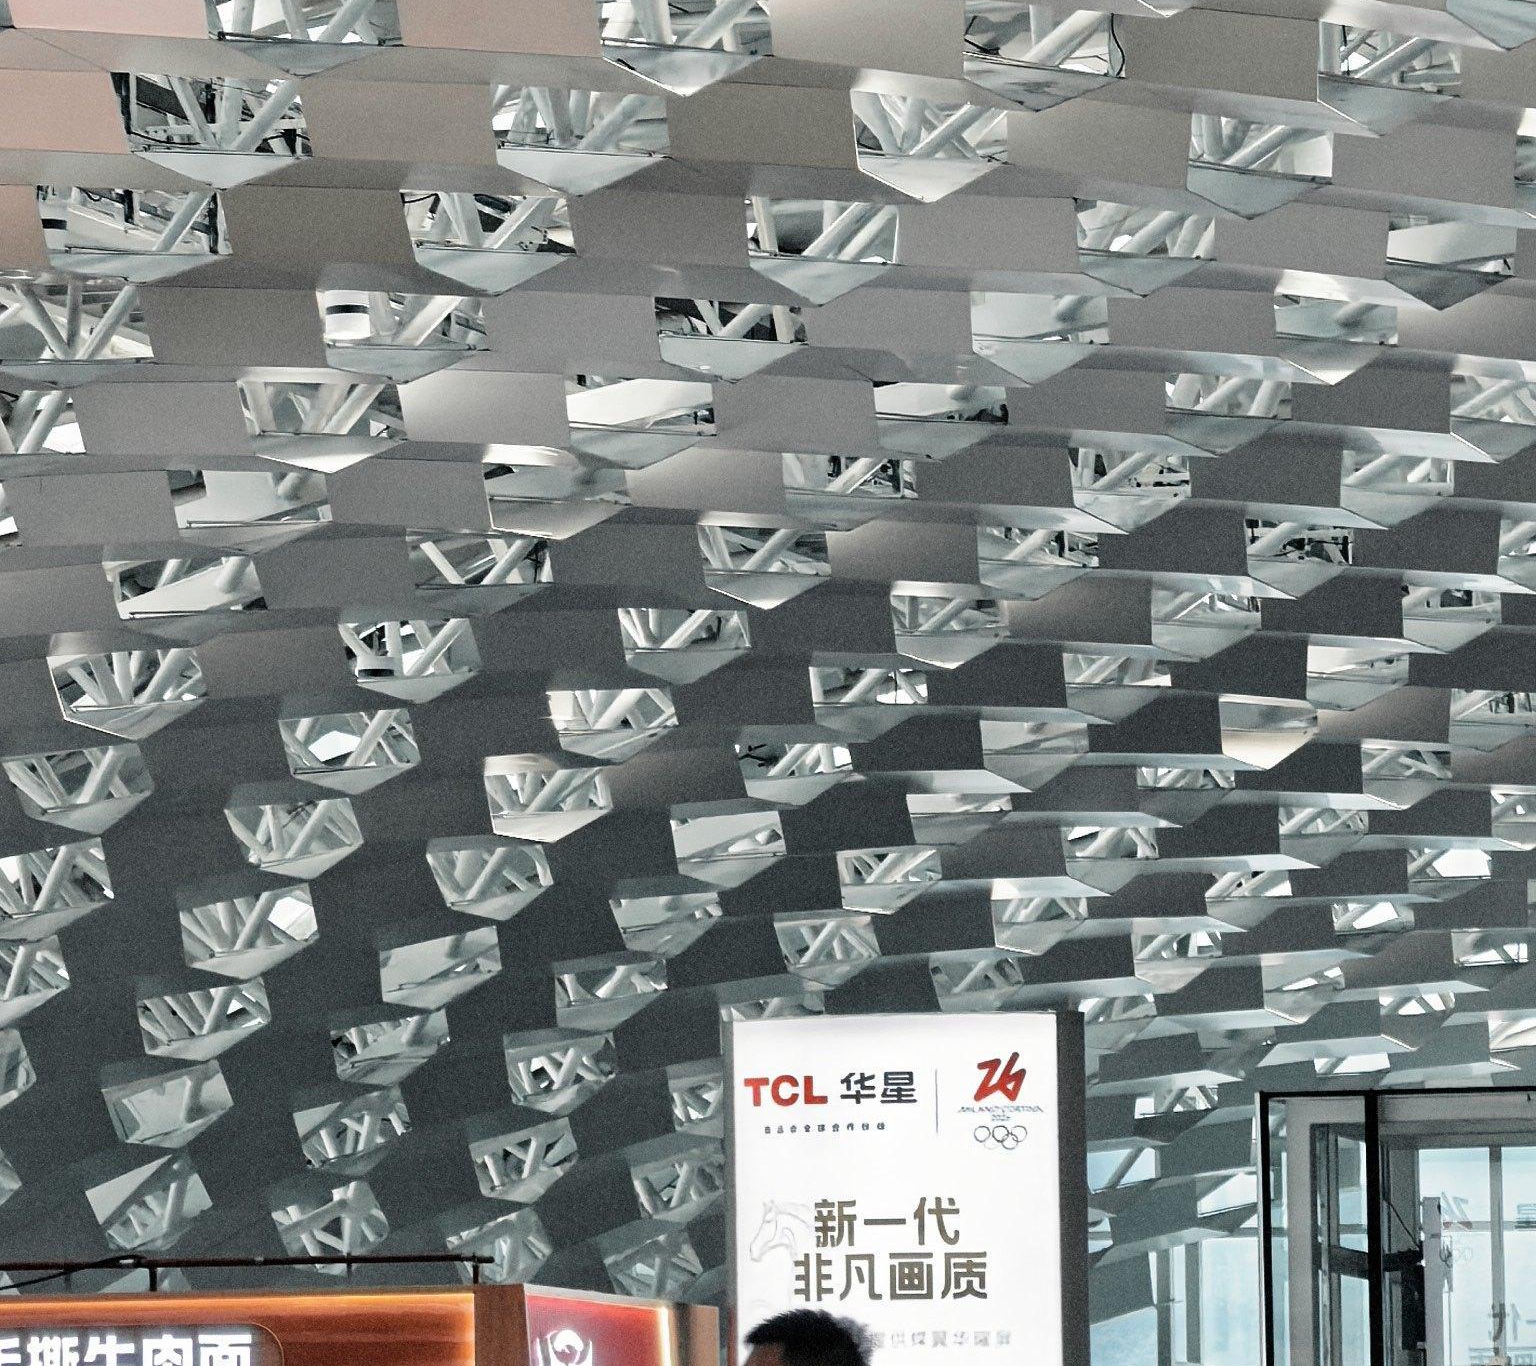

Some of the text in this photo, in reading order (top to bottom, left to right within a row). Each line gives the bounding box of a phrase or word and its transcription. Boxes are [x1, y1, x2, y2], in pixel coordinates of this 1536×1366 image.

[744, 1071, 917, 1106] TCL 华星
[814, 1196, 960, 1248] 新一代
[794, 1251, 988, 1301] 非凡画质
